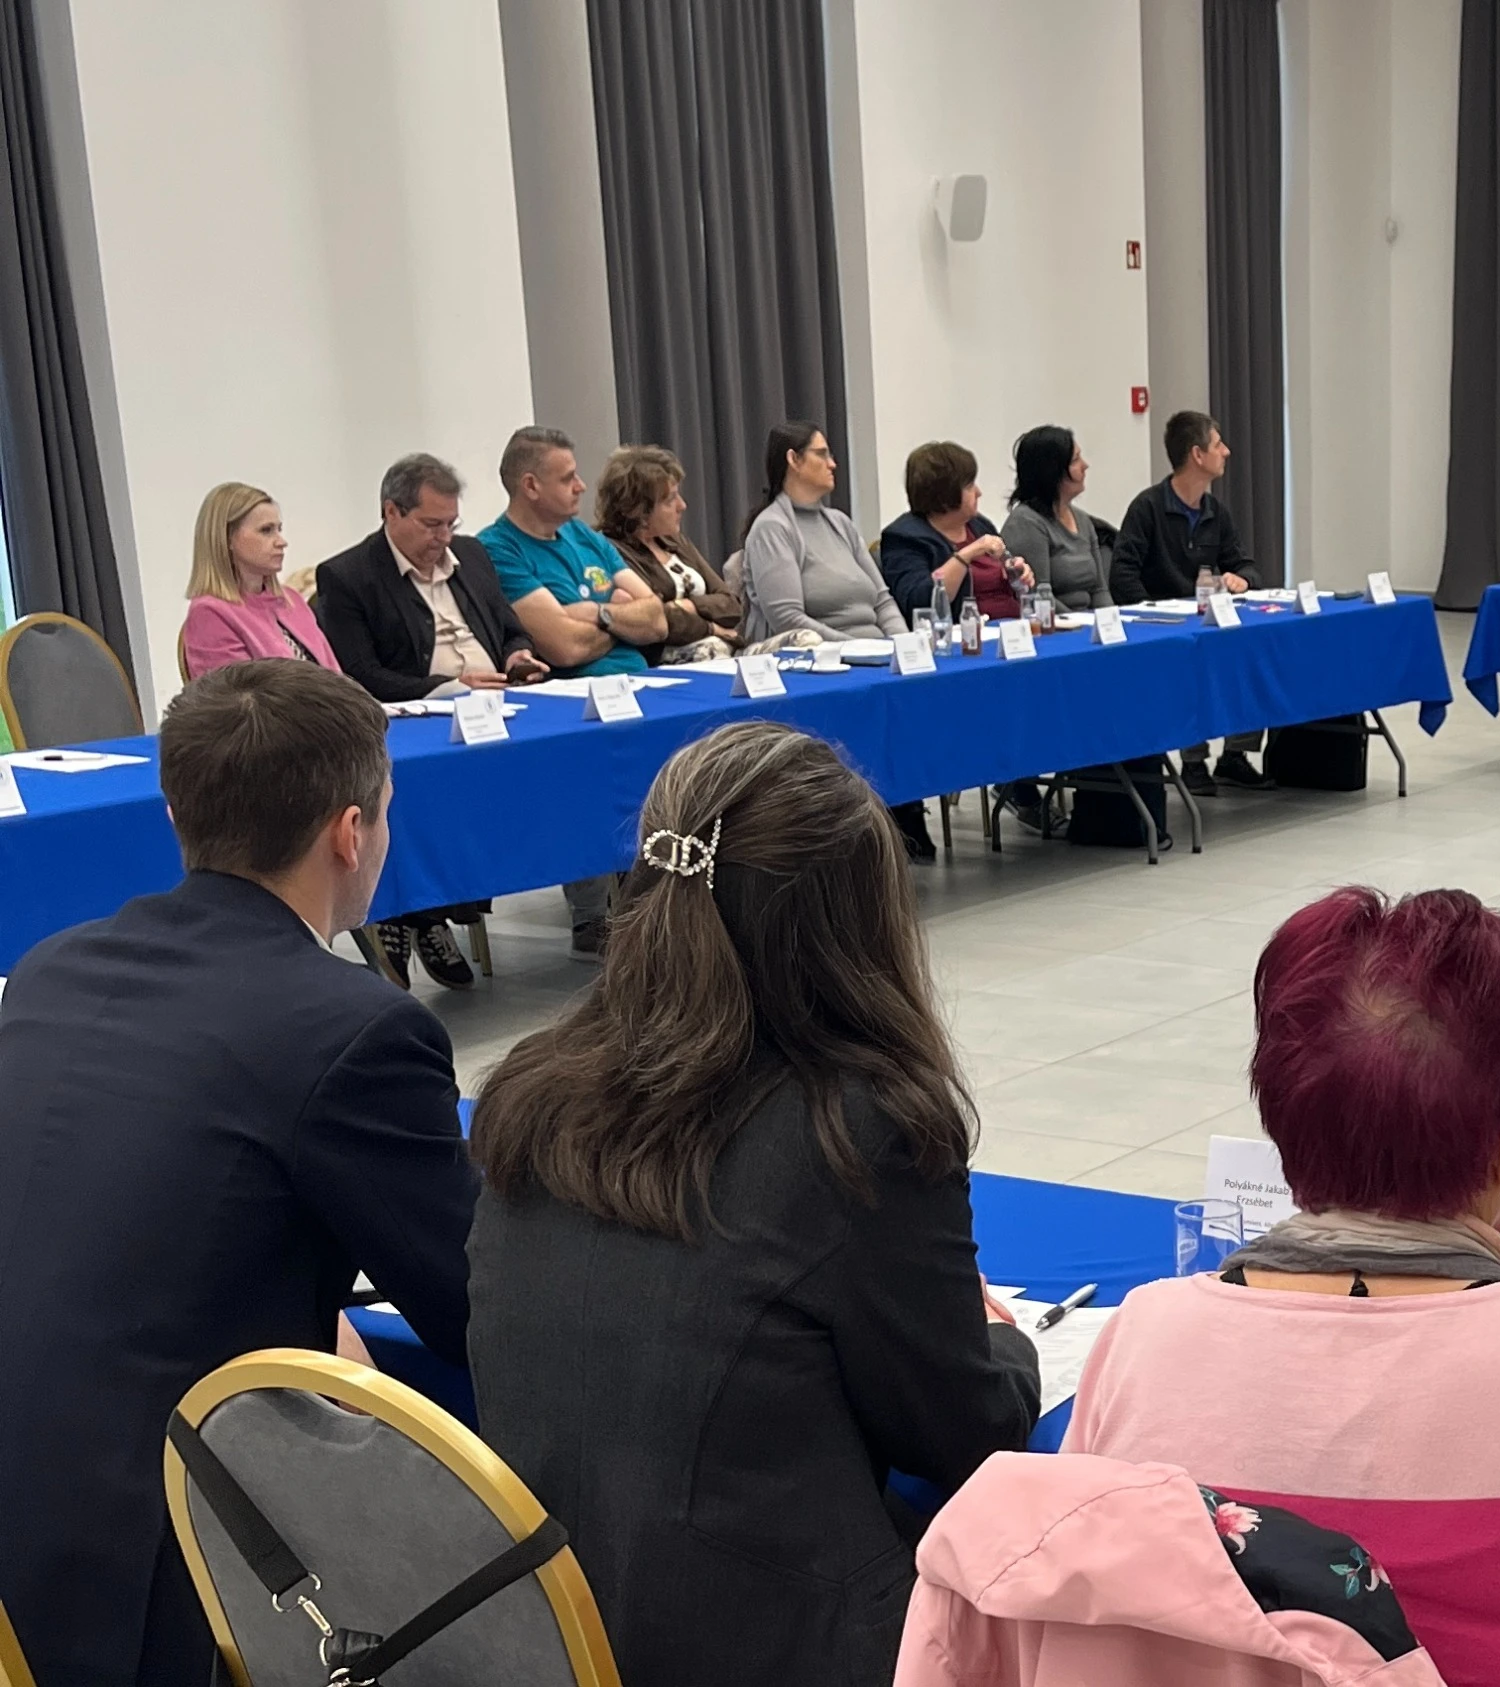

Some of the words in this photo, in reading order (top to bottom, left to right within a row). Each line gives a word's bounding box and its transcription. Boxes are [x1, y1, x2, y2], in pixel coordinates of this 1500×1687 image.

[1224, 1178, 1263, 1193] Polyákné
[1264, 1184, 1290, 1196] Jakab
[1236, 1195, 1273, 1209] Erzsébet
